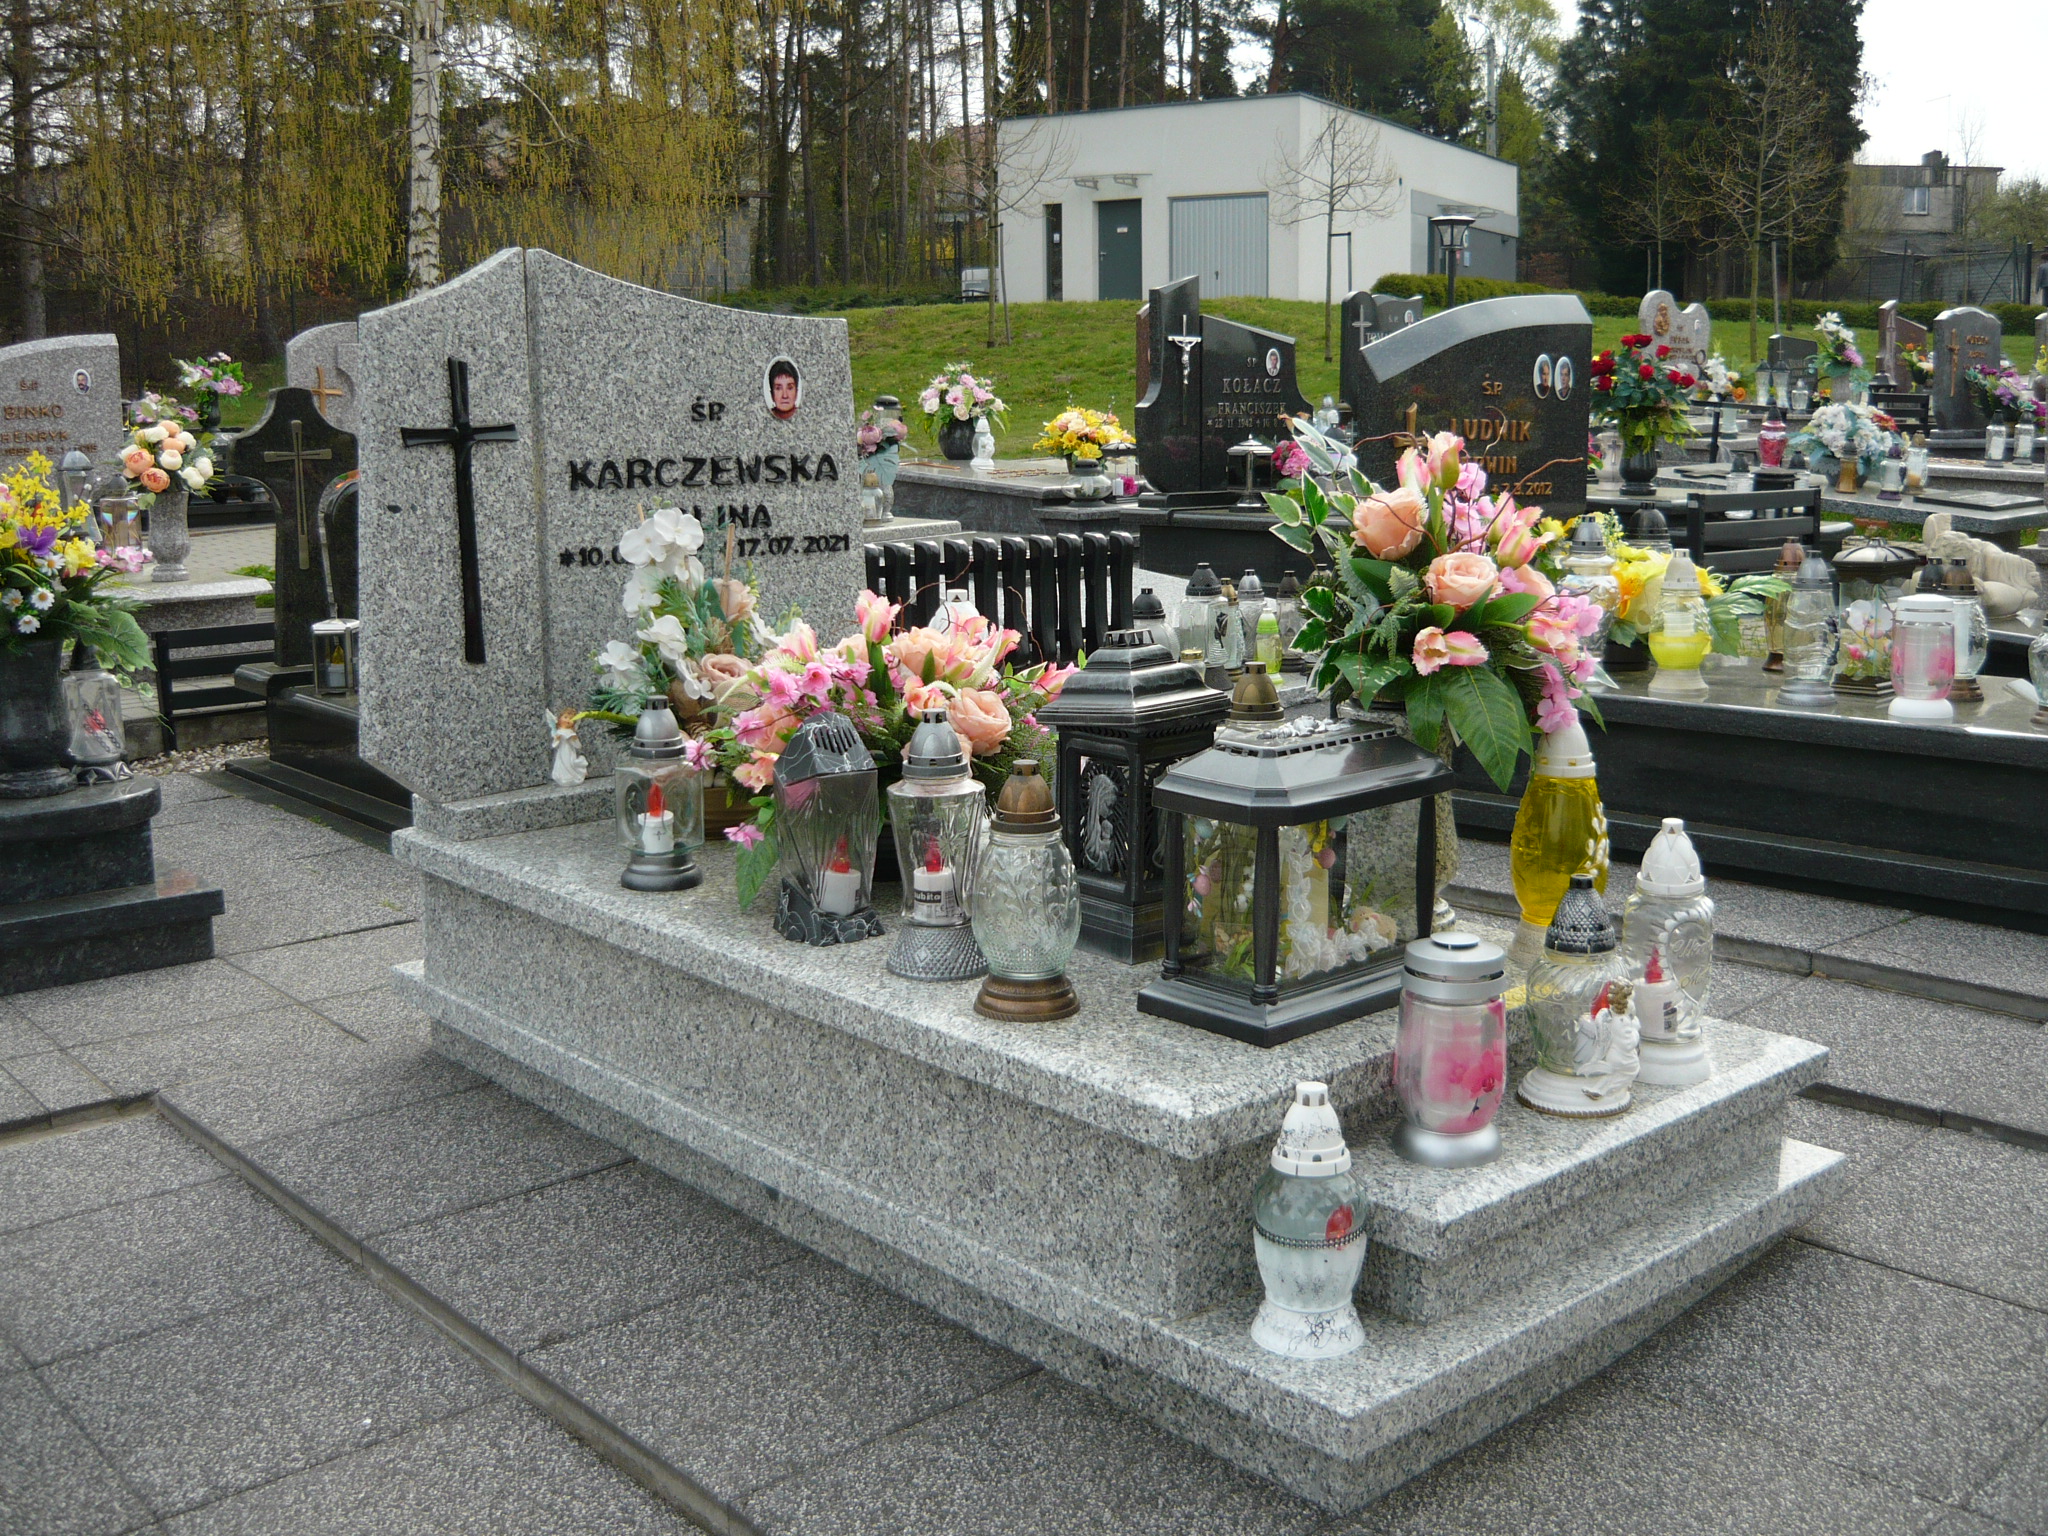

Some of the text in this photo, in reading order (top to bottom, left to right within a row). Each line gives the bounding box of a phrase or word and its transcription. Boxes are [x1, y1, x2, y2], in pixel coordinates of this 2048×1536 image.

[1222, 378, 1281, 393] KOŁACZ
[4, 404, 64, 420] BINKO
[0, 430, 69, 443] HENRYK
[569, 453, 839, 491] KARCZEWSKA
[737, 533, 851, 558] 17.07.2021
